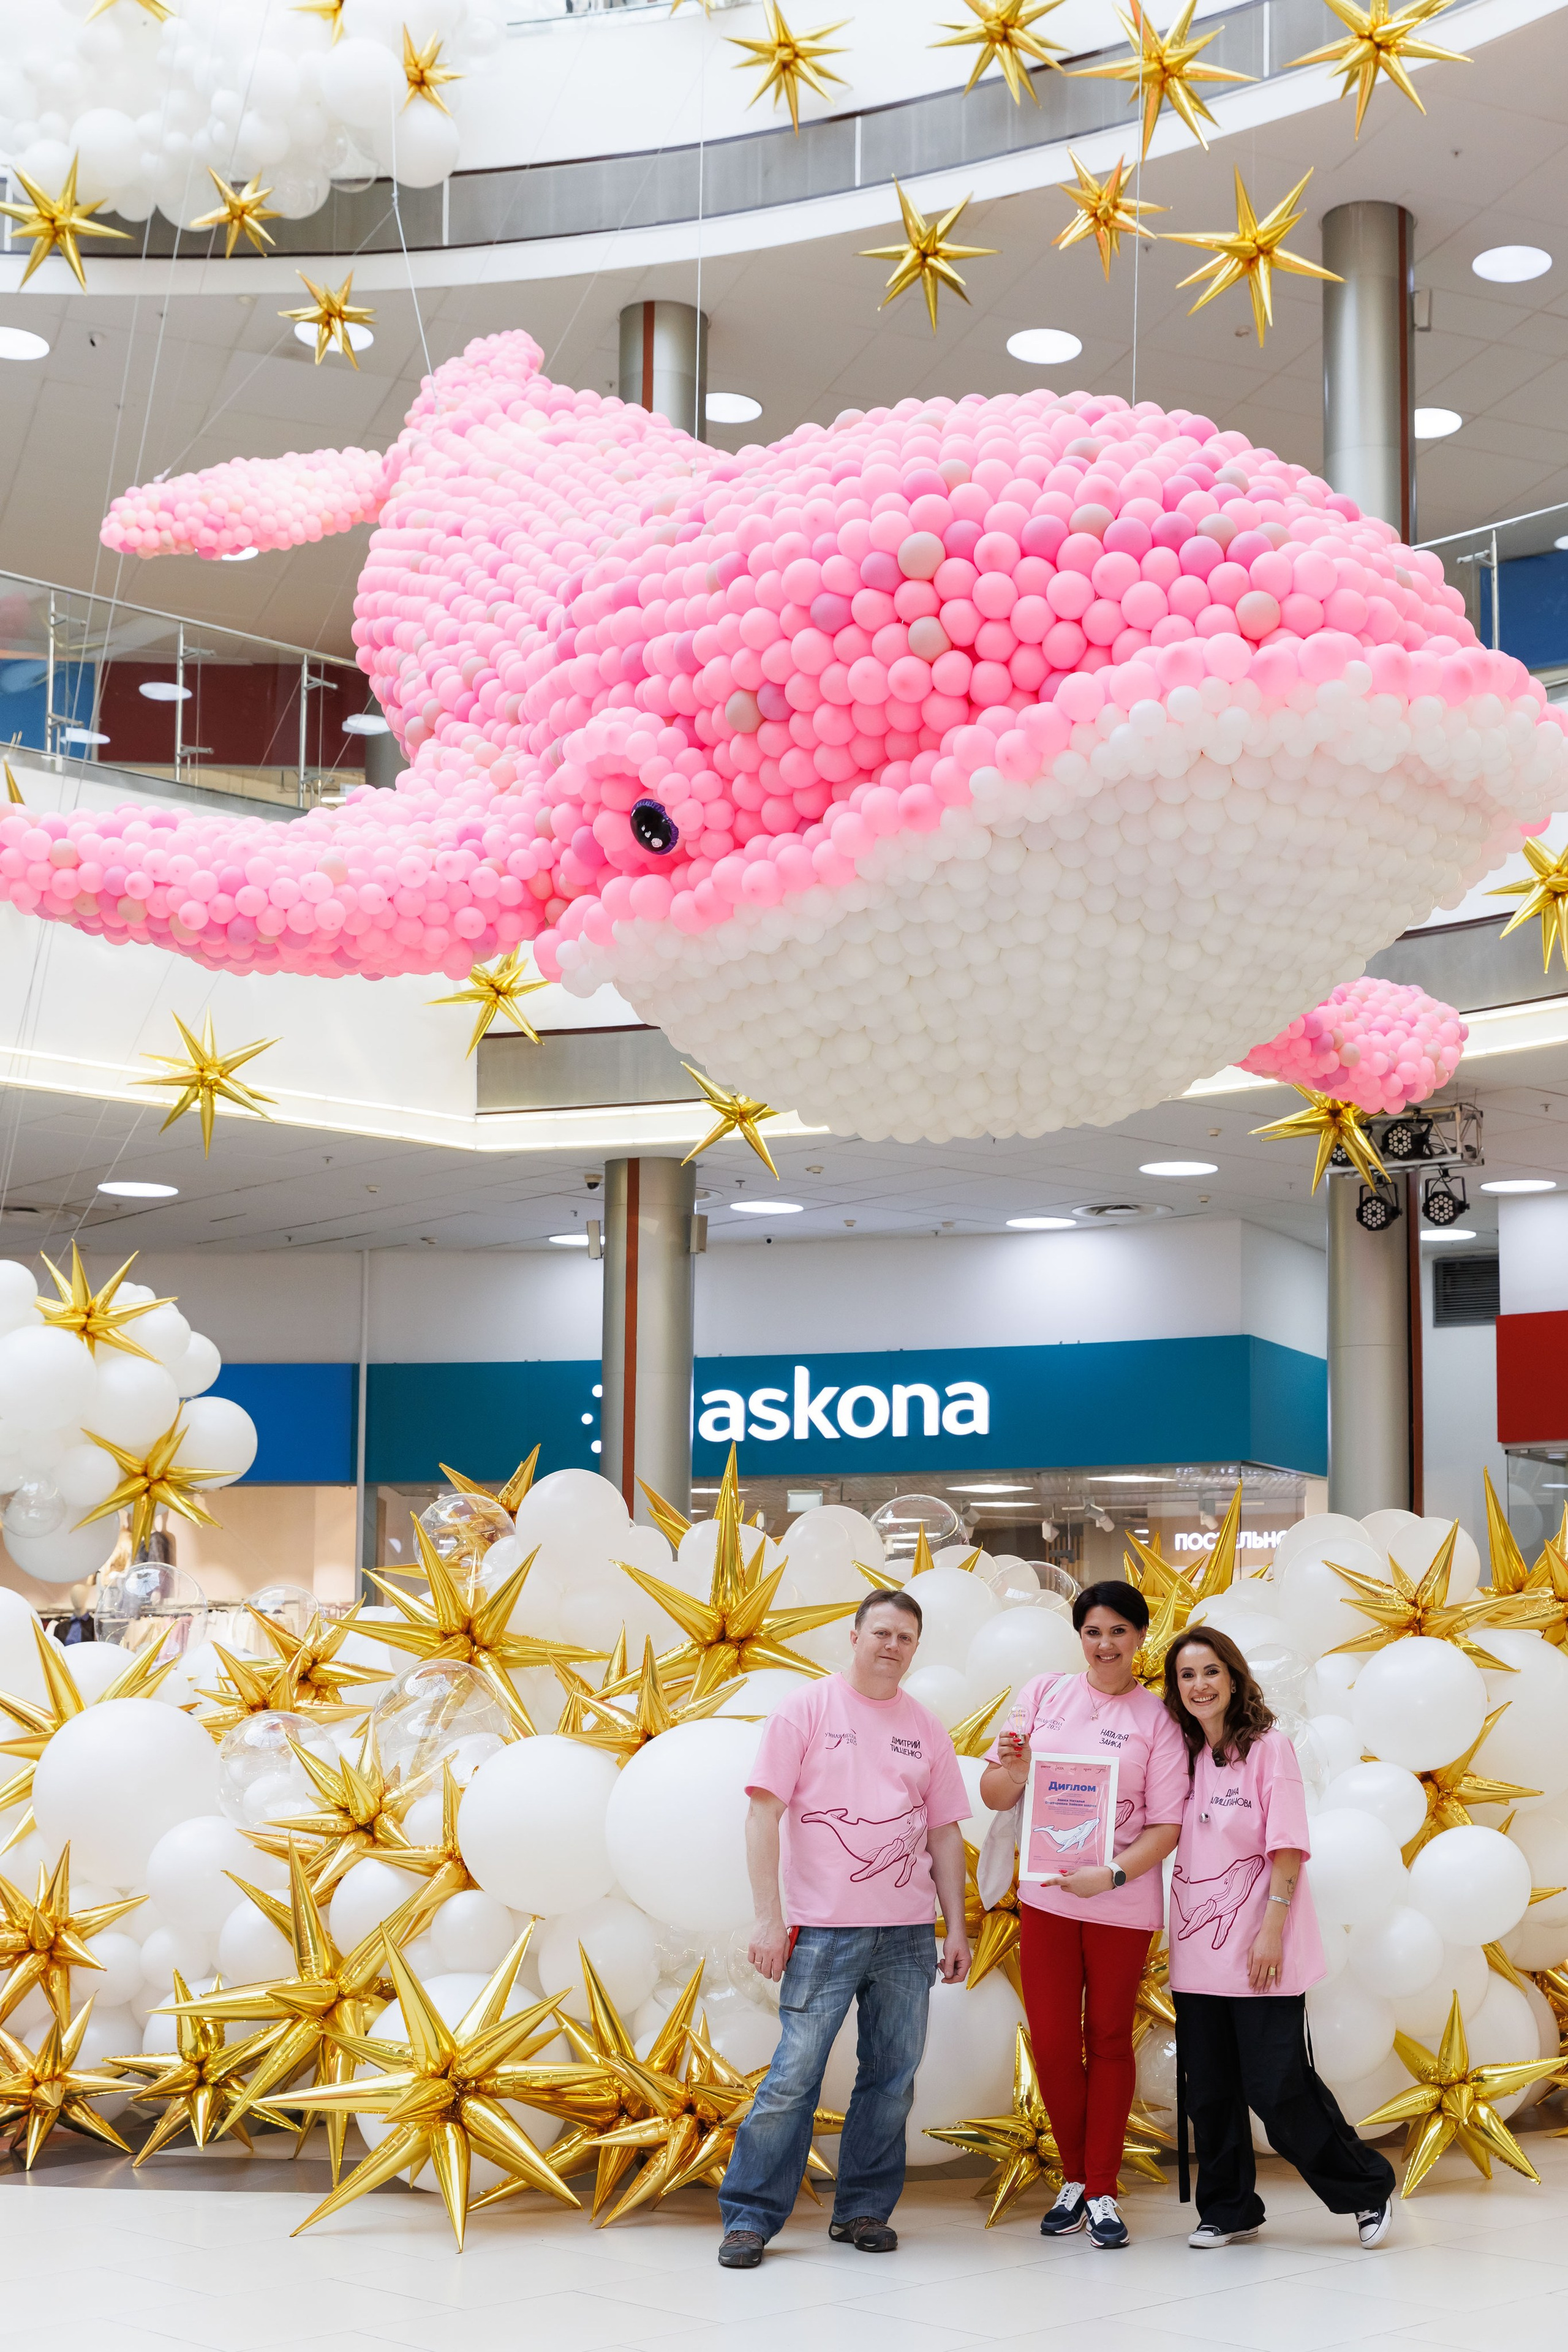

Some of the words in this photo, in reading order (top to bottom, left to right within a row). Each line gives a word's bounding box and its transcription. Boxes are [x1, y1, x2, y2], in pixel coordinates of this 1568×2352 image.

[698, 1365, 990, 1442] askona
[1175, 1530, 1287, 1551] ПОСЛЬН
[1100, 1728, 1129, 1741] НАТАЛЬЯ
[892, 1736, 920, 1749] ДМИТРИЙ
[1099, 1738, 1121, 1749] ЗАИКА
[890, 1744, 922, 1759] ТИЩЕНКО
[1048, 1781, 1096, 1792] Диплом
[1226, 1787, 1239, 1798] ДИНА
